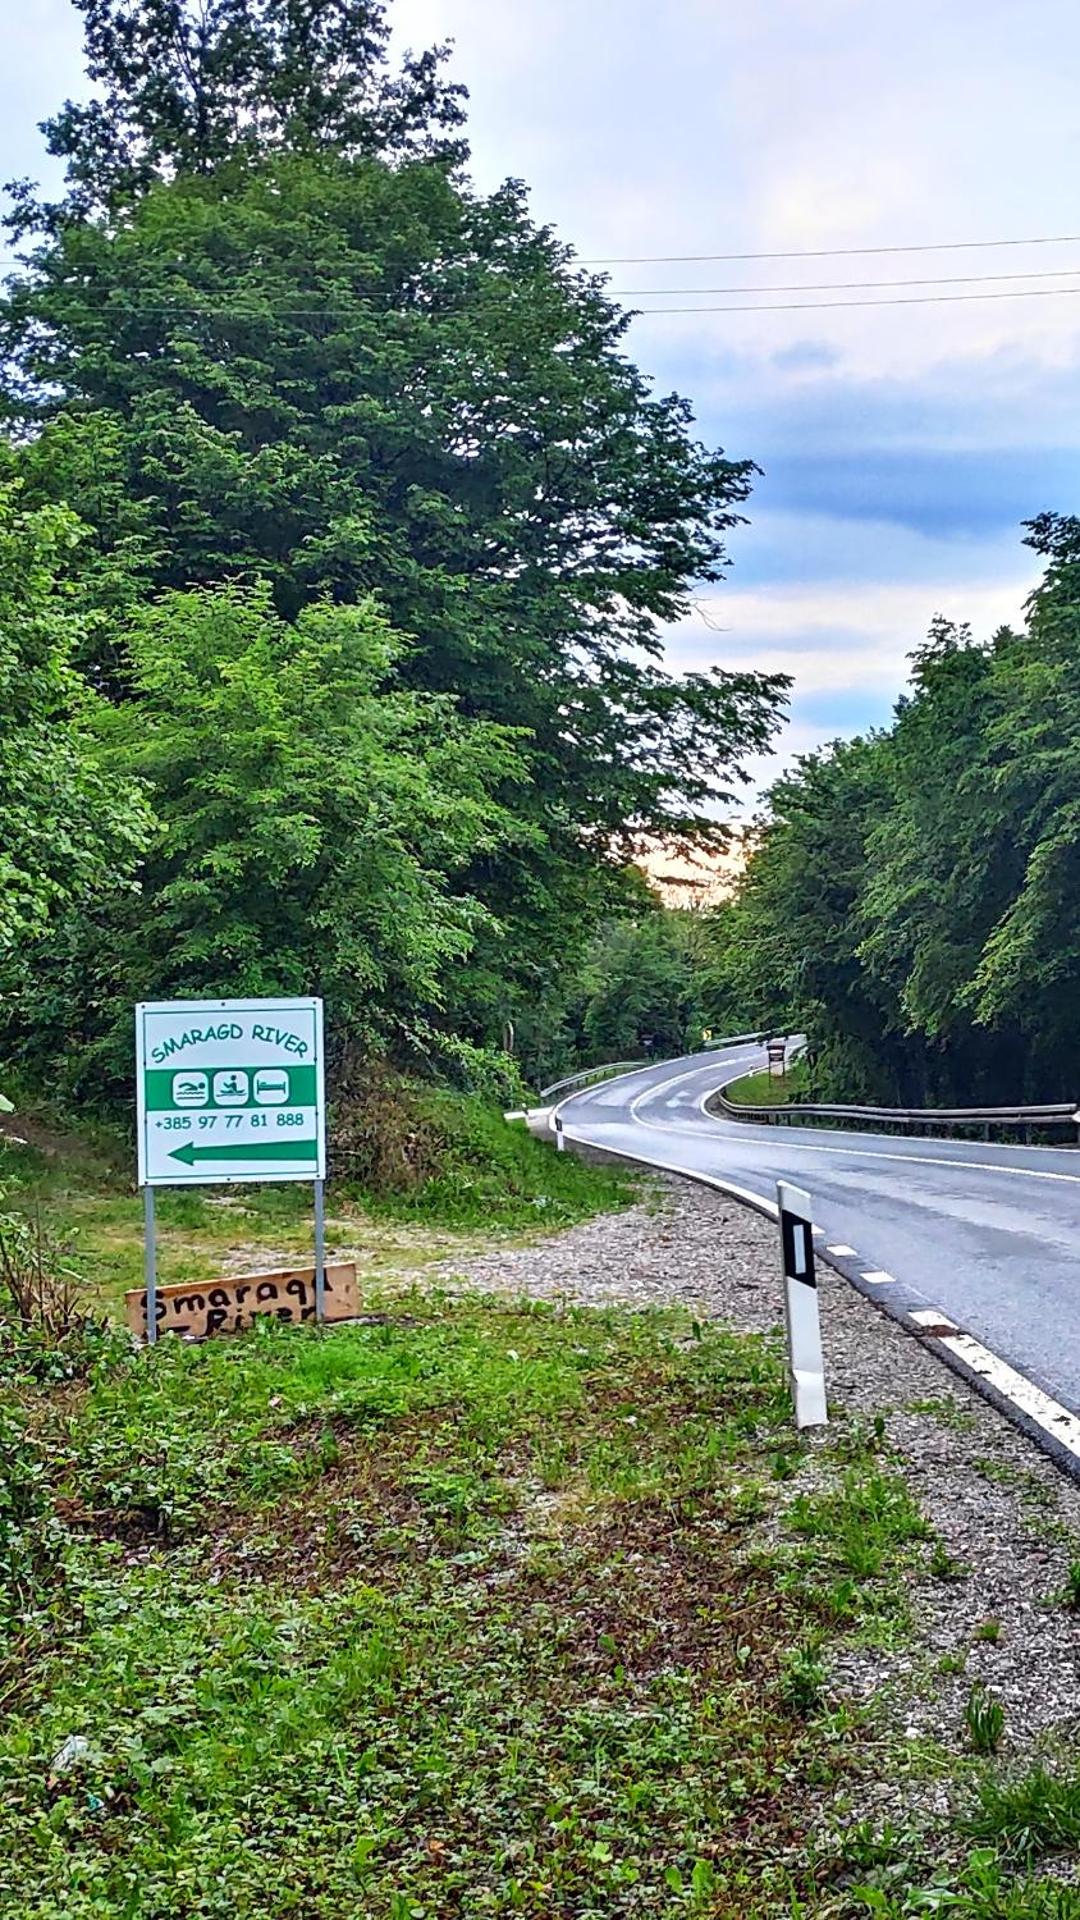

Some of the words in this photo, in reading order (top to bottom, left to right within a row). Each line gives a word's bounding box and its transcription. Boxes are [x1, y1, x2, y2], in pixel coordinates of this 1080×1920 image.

[151, 1023, 243, 1064] SMARAGD
[252, 1024, 308, 1058] RIVER
[155, 1116, 191, 1130] +385
[198, 1115, 218, 1129] 97
[224, 1114, 244, 1128] 77
[250, 1114, 267, 1128] 81
[276, 1113, 304, 1127] 888
